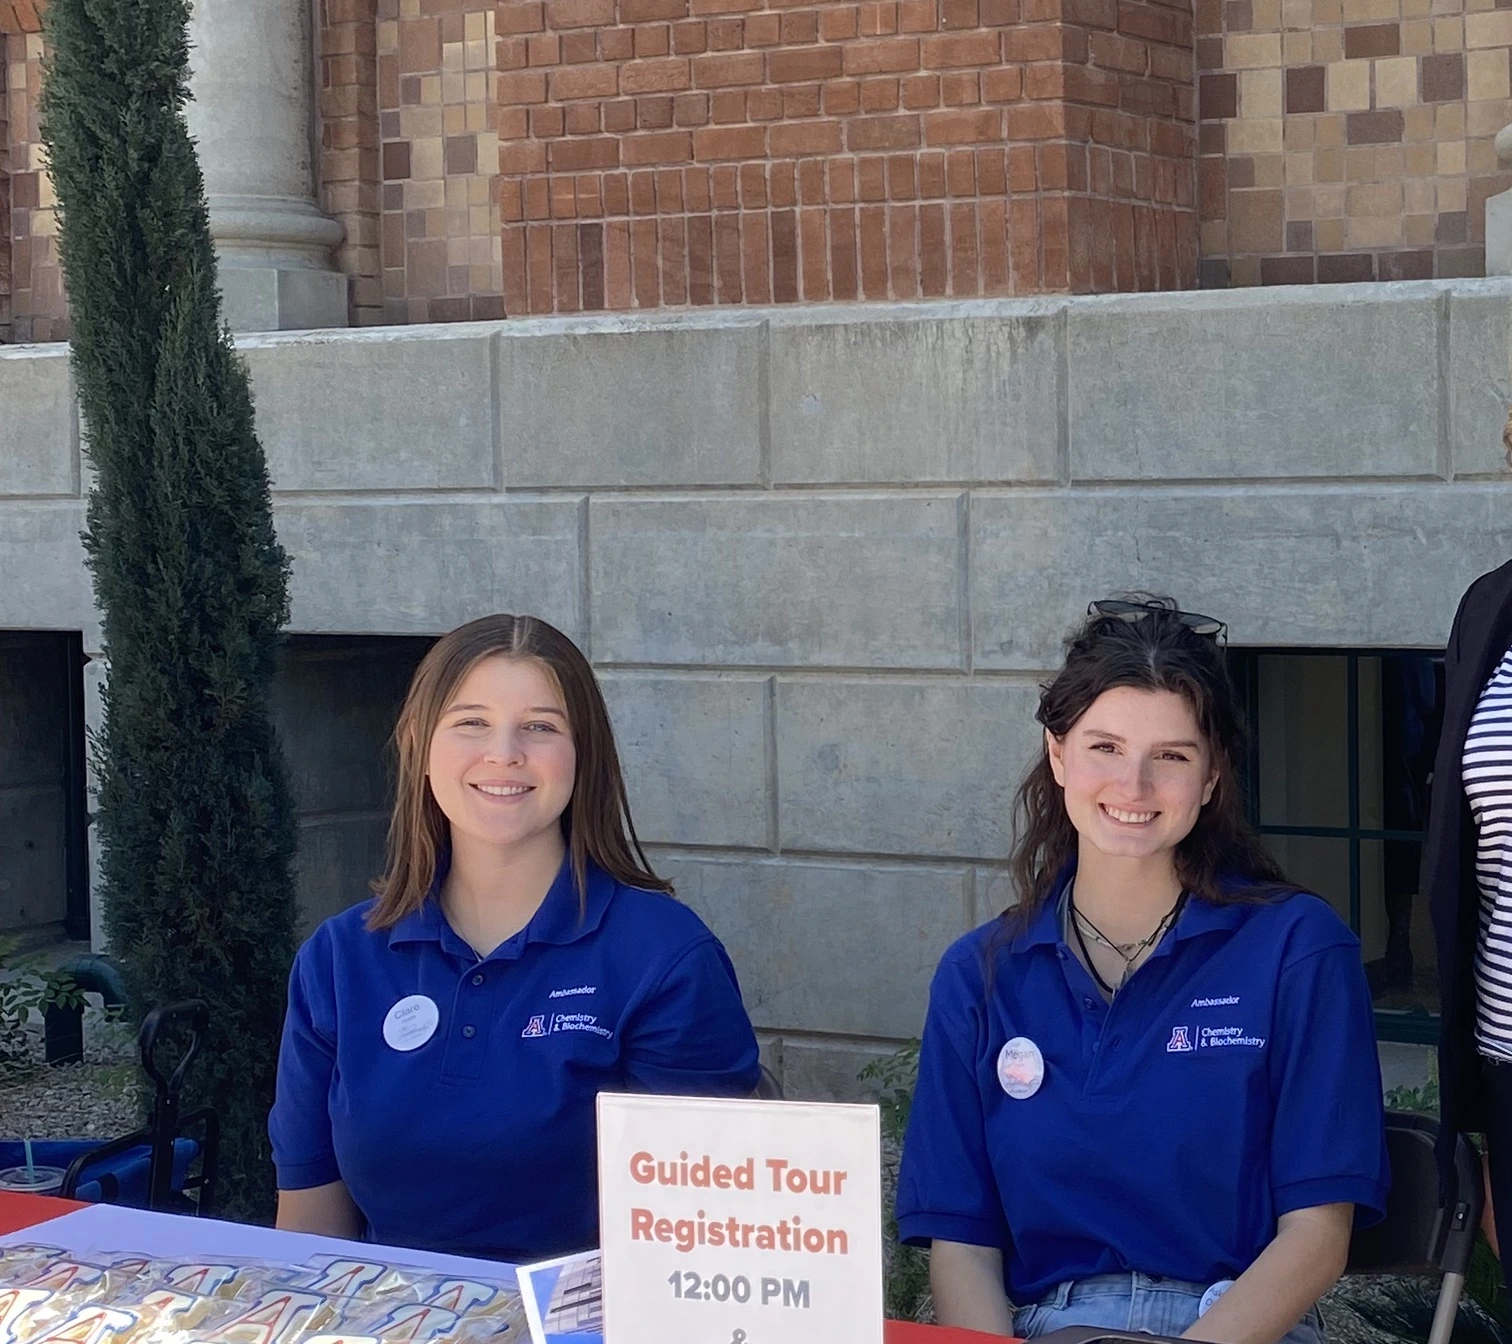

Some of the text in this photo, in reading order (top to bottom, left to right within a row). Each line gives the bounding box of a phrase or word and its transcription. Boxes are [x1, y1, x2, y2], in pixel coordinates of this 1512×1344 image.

[1190, 994, 1241, 1008] Ambassador
[555, 1013, 598, 1026] Chemistry
[561, 1021, 614, 1040] Biochemistry
[1201, 1026, 1244, 1038] Chemistry
[1200, 1036, 1267, 1049] & Biochemistry
[629, 1151, 848, 1196] Guided Tour
[630, 1208, 849, 1255] Registration
[667, 1270, 811, 1309] 12:00 PM
